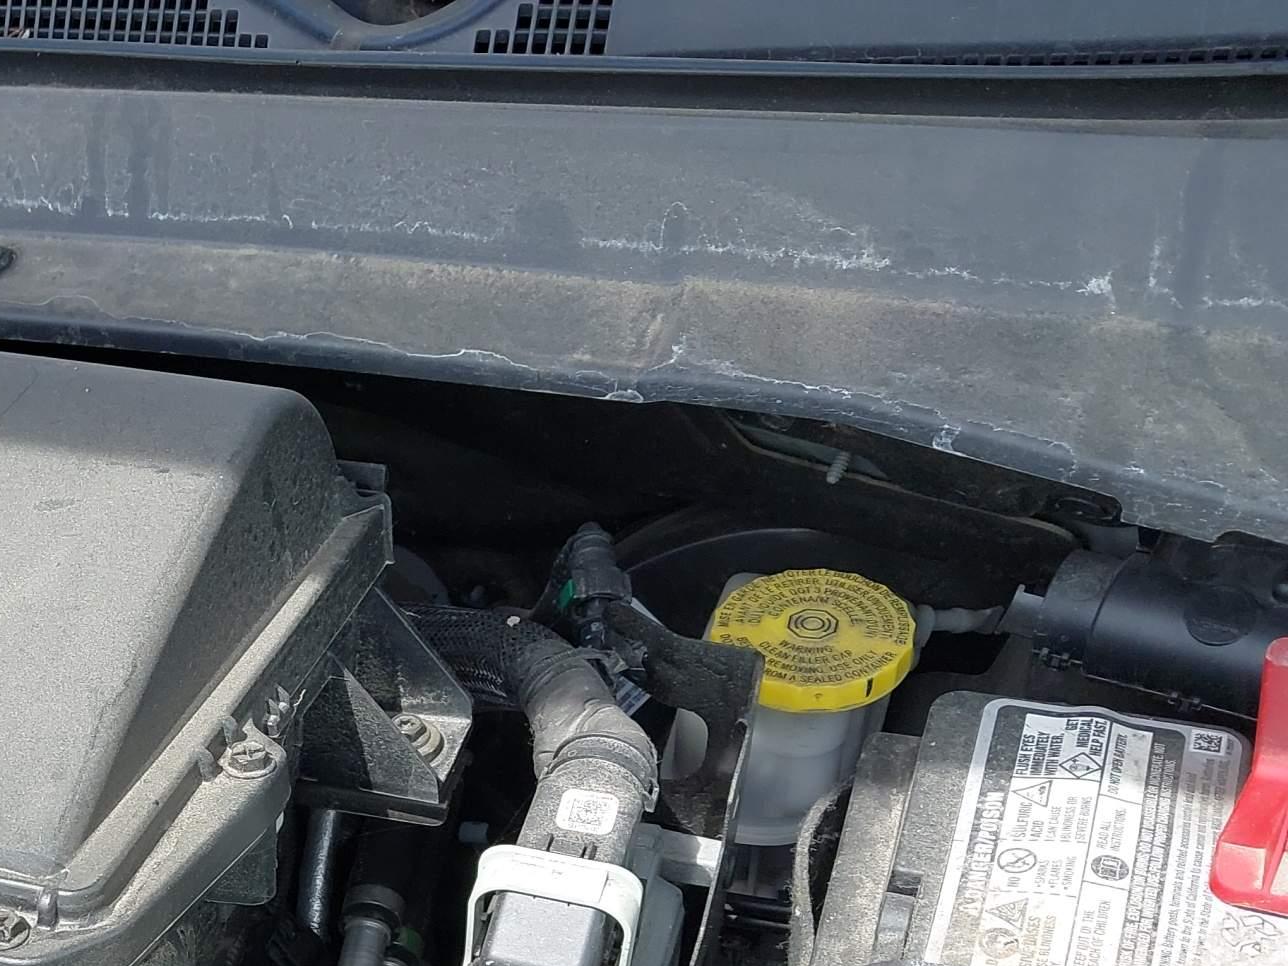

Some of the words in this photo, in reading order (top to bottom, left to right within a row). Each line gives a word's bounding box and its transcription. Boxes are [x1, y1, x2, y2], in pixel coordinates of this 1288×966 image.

[789, 587, 811, 596] DOT
[759, 641, 792, 661] CLEAN
[792, 653, 829, 666] FILLER
[831, 650, 853, 664] CAP
[829, 661, 851, 673] USE
[852, 650, 878, 666] ONLY
[799, 672, 843, 684] SEALED
[843, 651, 898, 680] CONTAINER
[1065, 718, 1078, 730] GET
[1075, 718, 1093, 748] MEDICAL
[1092, 720, 1107, 737] FAST.
[1020, 733, 1035, 752] EYES
[1047, 732, 1064, 758] WATER.
[1089, 739, 1103, 755] HELP
[1112, 733, 1127, 757] BATTERY.
[1029, 731, 1050, 775] IMMEDIATELY
[1015, 753, 1031, 775] FLUSH
[1043, 758, 1059, 776] WITH
[1110, 758, 1123, 772] OPEN
[1108, 772, 1121, 785] NOT
[1106, 785, 1118, 793] DO
[1012, 801, 1033, 837] SULFURIC
[1098, 820, 1111, 830] ALL
[1029, 820, 1044, 837] ACID
[1095, 831, 1109, 848] READ
[1006, 875, 1020, 887] NO
[1081, 909, 1094, 922] THE
[1094, 899, 1111, 935] CHILDREN
[1038, 914, 1056, 956] BLINDNESS
[1076, 935, 1089, 950] OUT
[1162, 926, 1177, 948] Battery
